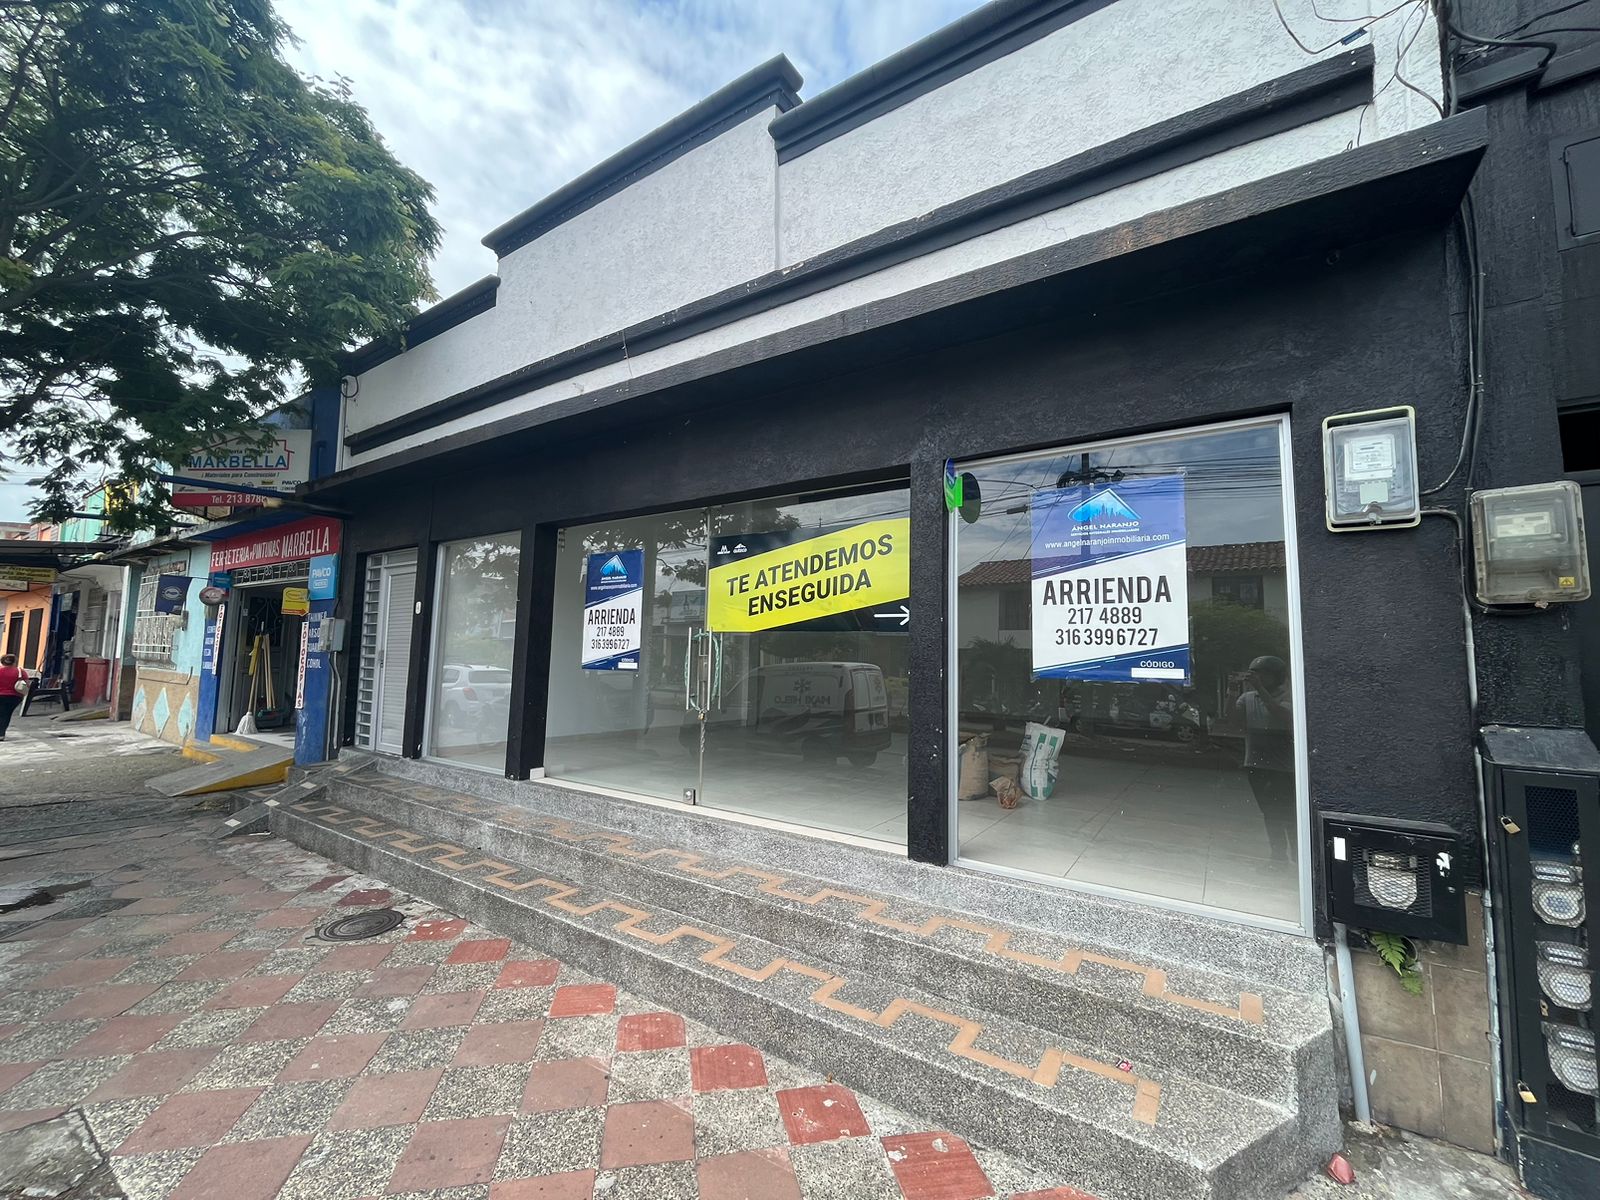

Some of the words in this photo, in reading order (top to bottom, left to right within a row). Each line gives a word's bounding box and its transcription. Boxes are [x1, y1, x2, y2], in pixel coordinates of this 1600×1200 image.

[190, 455, 287, 468] MARBELLA
[226, 494, 243, 504] 213
[1100, 520, 1139, 528] NARANJO
[282, 526, 330, 558] MARBELLA
[1045, 533, 1170, 549] www.angelnaranjoinmobiliaria.com
[726, 574, 750, 597] TE
[754, 534, 894, 590] ATENDEMOS
[748, 568, 872, 617] ENSEGUIDA
[1042, 575, 1172, 606] ARRIENDA
[588, 608, 636, 626] ARRIENDA
[1068, 607, 1093, 624] 217
[1099, 606, 1142, 624] 4889
[596, 626, 606, 637] 217
[608, 626, 624, 637] 4889
[1140, 660, 1174, 668] CÓDIGO
